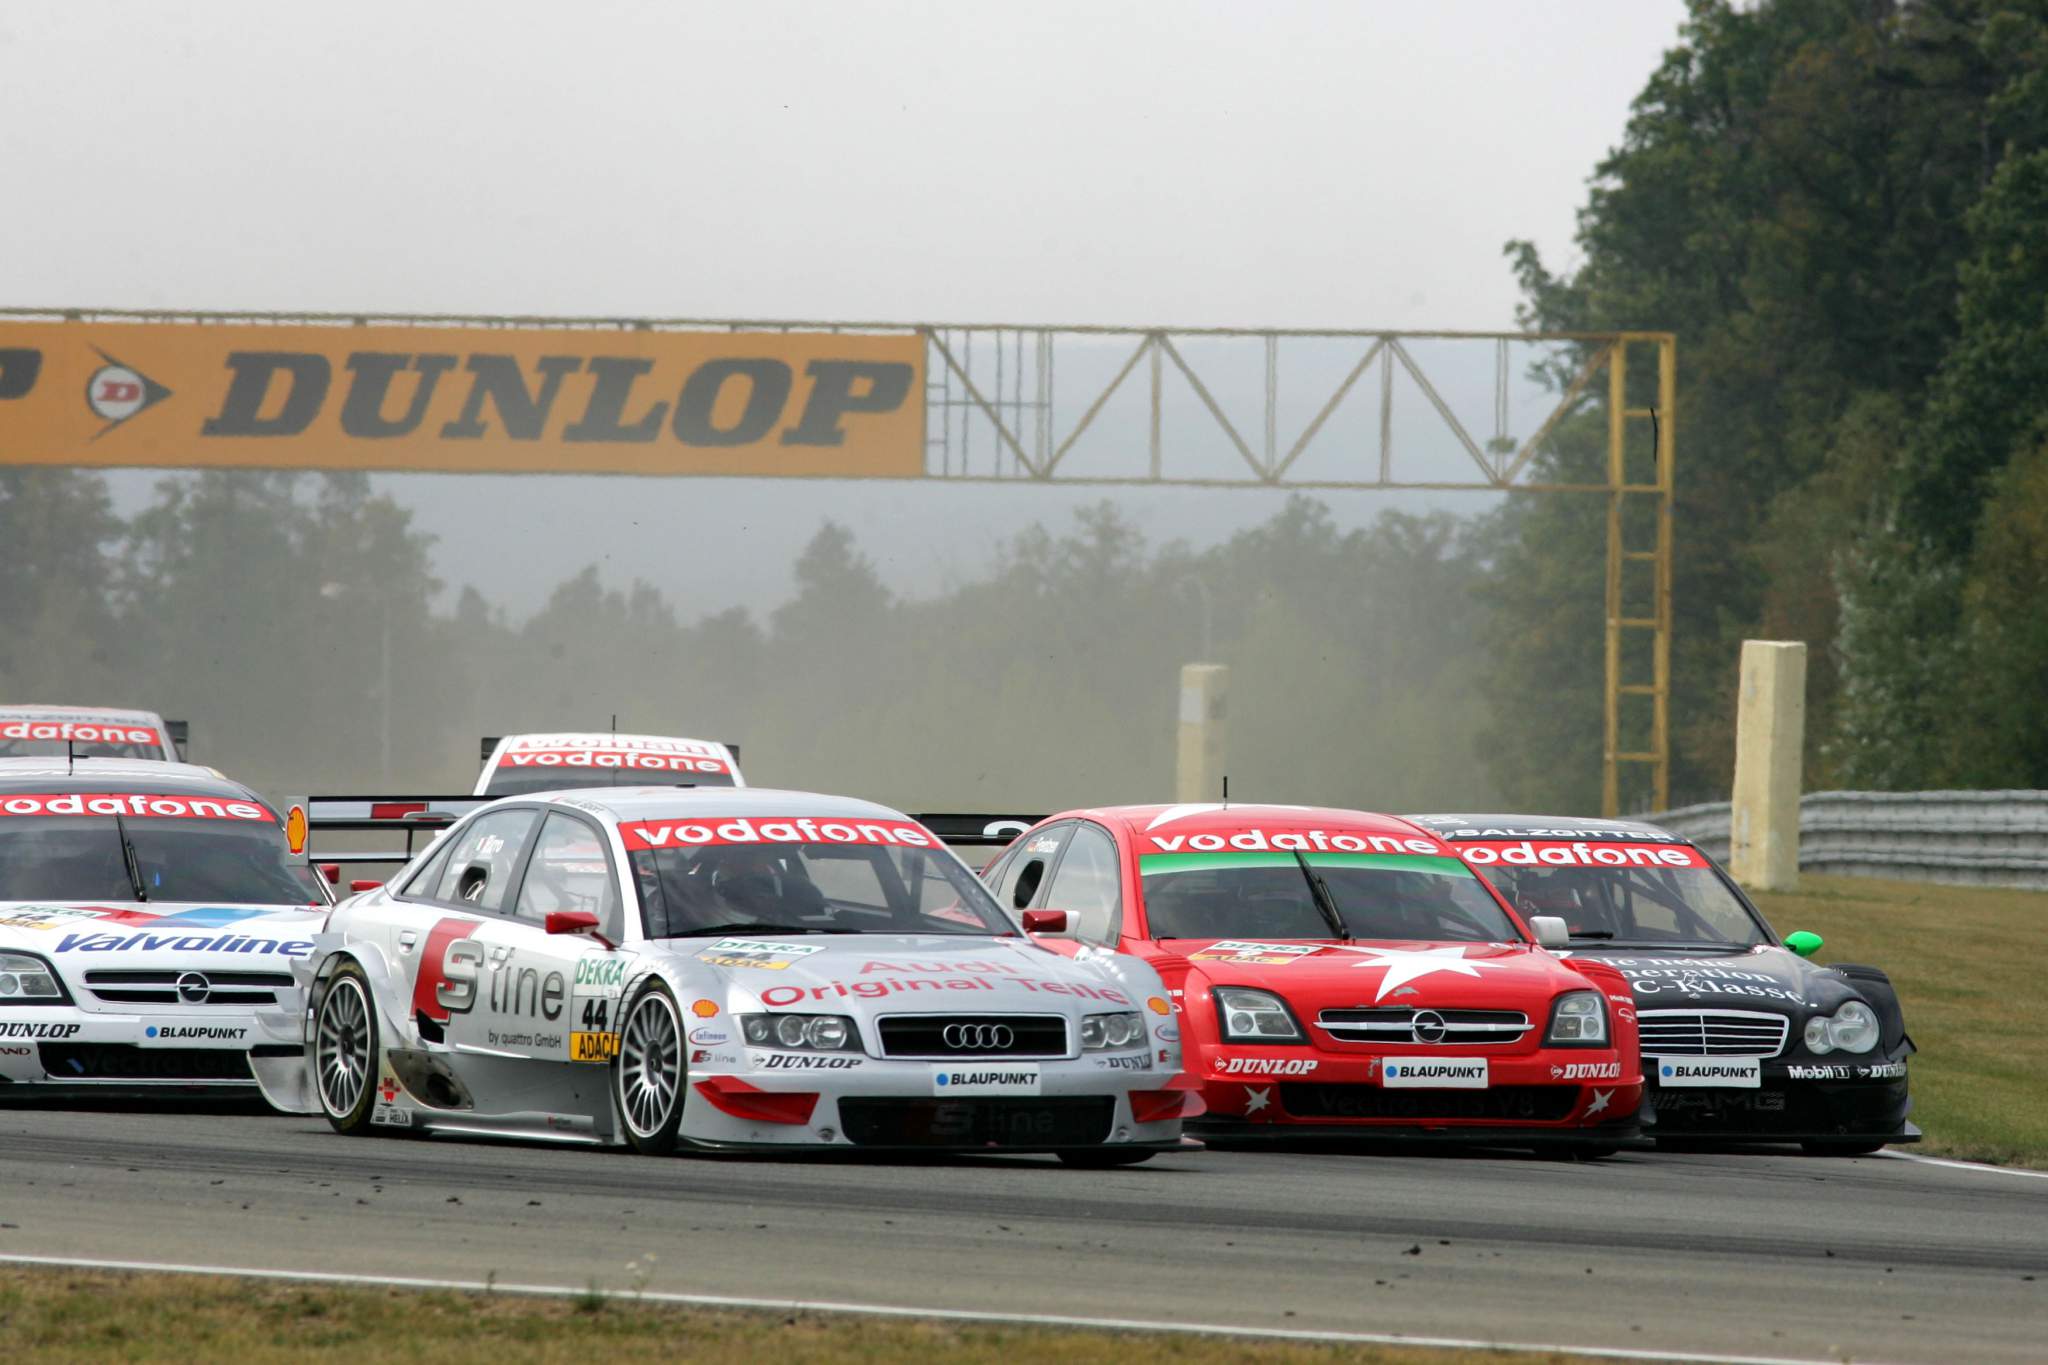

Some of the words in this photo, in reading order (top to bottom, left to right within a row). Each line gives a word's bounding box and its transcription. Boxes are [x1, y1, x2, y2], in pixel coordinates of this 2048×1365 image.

[201, 350, 914, 447] DUNLOP
[0, 723, 152, 743] dafone
[511, 751, 721, 771] vodafone
[0, 795, 261, 820] odafone
[634, 819, 929, 846] vodafone
[1151, 829, 1439, 854] vodafone
[1454, 829, 1676, 841] SALZGITTER
[1457, 843, 1692, 865] odafone
[55, 932, 316, 956] Valvoline
[714, 941, 813, 953] DEKRA
[575, 958, 626, 985] DEKRA
[859, 960, 1020, 975] Audi
[1622, 968, 1780, 984] neration
[760, 976, 993, 1007] Original
[1005, 976, 1130, 1005] Teile
[582, 998, 608, 1032] 44
[159, 1026, 248, 1040] BLAUPUNKT
[488, 1028, 499, 1046] by
[579, 1034, 610, 1059] ADAC
[765, 1054, 863, 1070] DUNLOP
[1225, 1059, 1318, 1075] DUNLOP
[1563, 1062, 1620, 1079] DUNLO
[950, 1072, 1038, 1086] BLAUPUNKT
[1399, 1066, 1485, 1079] BLAUPUNKT
[1675, 1066, 1758, 1079] BLAUPUNKT
[1789, 1065, 1833, 1079] Mobil
